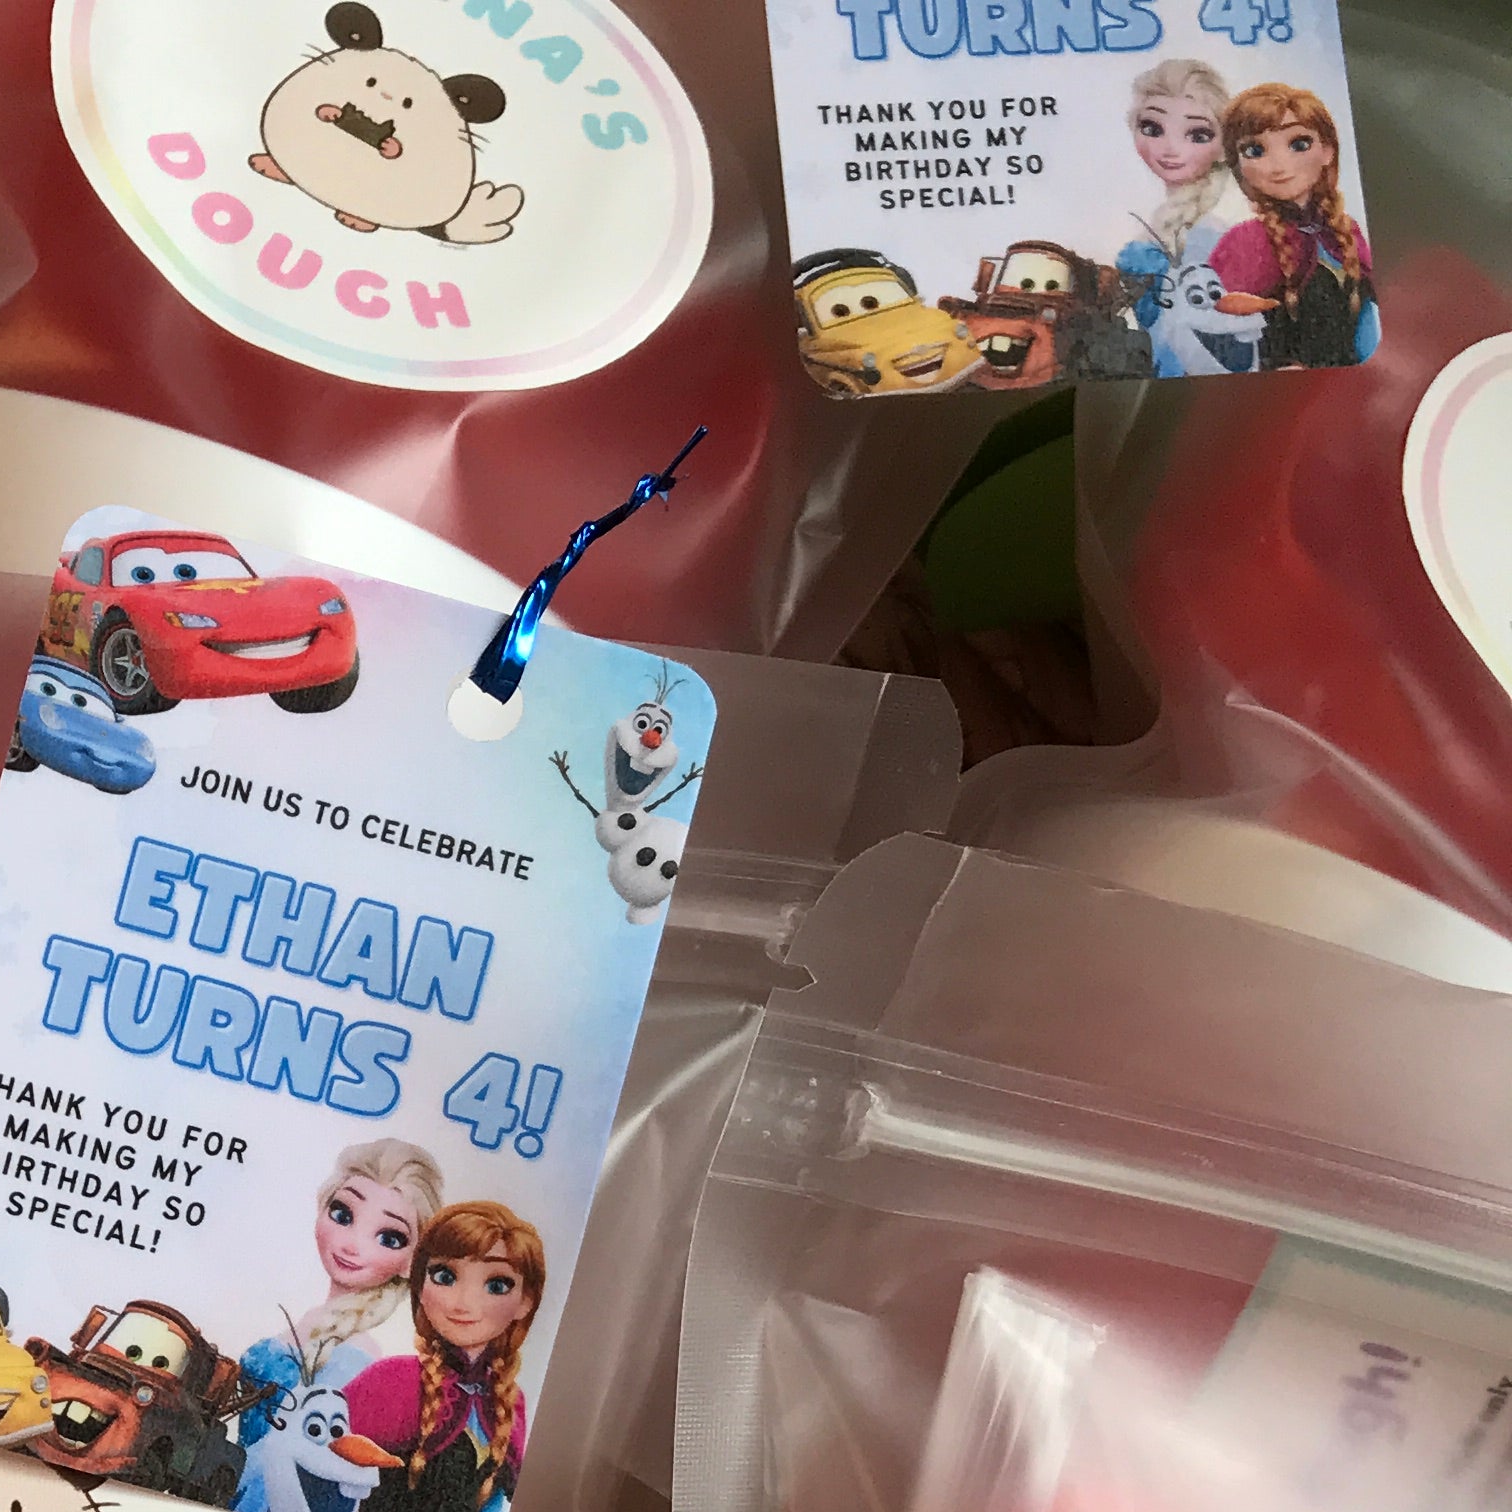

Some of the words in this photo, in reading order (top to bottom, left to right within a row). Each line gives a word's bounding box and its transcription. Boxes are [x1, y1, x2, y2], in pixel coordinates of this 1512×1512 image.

[836, 0, 1164, 61] TURNS
[817, 102, 915, 125] THANK
[927, 99, 987, 121] YOU
[1001, 96, 1059, 118] FOR
[855, 129, 972, 153] MAKING
[985, 126, 1028, 147] MY
[844, 157, 993, 182] BIRTHDAY
[1006, 154, 1045, 175] SO
[879, 185, 1017, 210] SPECIAL!
[146, 131, 472, 329] DOUGH
[180, 766, 253, 804] JOIN
[262, 786, 303, 817] US
[314, 800, 350, 830] TO
[361, 814, 534, 881] CELEBRATE
[114, 836, 494, 1022] ETHAN
[42, 934, 412, 1117] TURNS
[442, 1052, 563, 1159] 4!
[3, 1114, 137, 1170] MAKING
[152, 1154, 202, 1187] MY
[103, 1102, 168, 1141] YOU
[182, 1125, 248, 1164] FOR
[5, 1191, 161, 1253] SPECIAL!
[162, 1196, 206, 1226] SO
